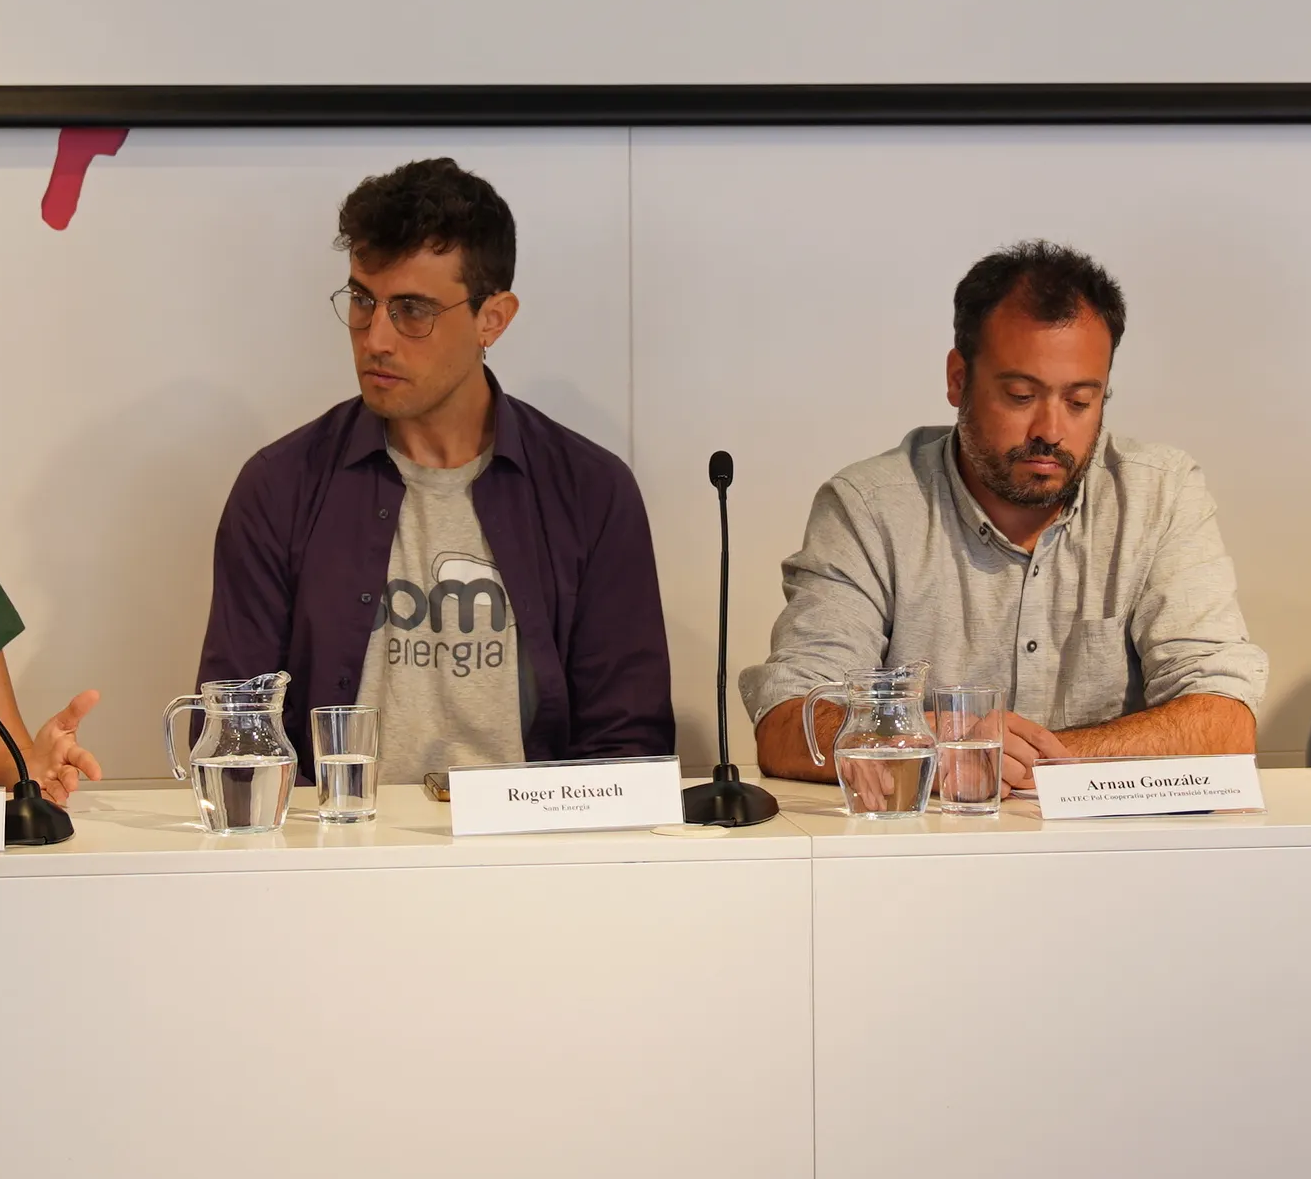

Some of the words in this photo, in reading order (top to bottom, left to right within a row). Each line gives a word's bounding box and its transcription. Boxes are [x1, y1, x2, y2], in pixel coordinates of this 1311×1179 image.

[1087, 779, 1136, 791] Arnau
[1140, 773, 1211, 788] González
[507, 787, 556, 804] Roger
[561, 783, 624, 800] Reixach
